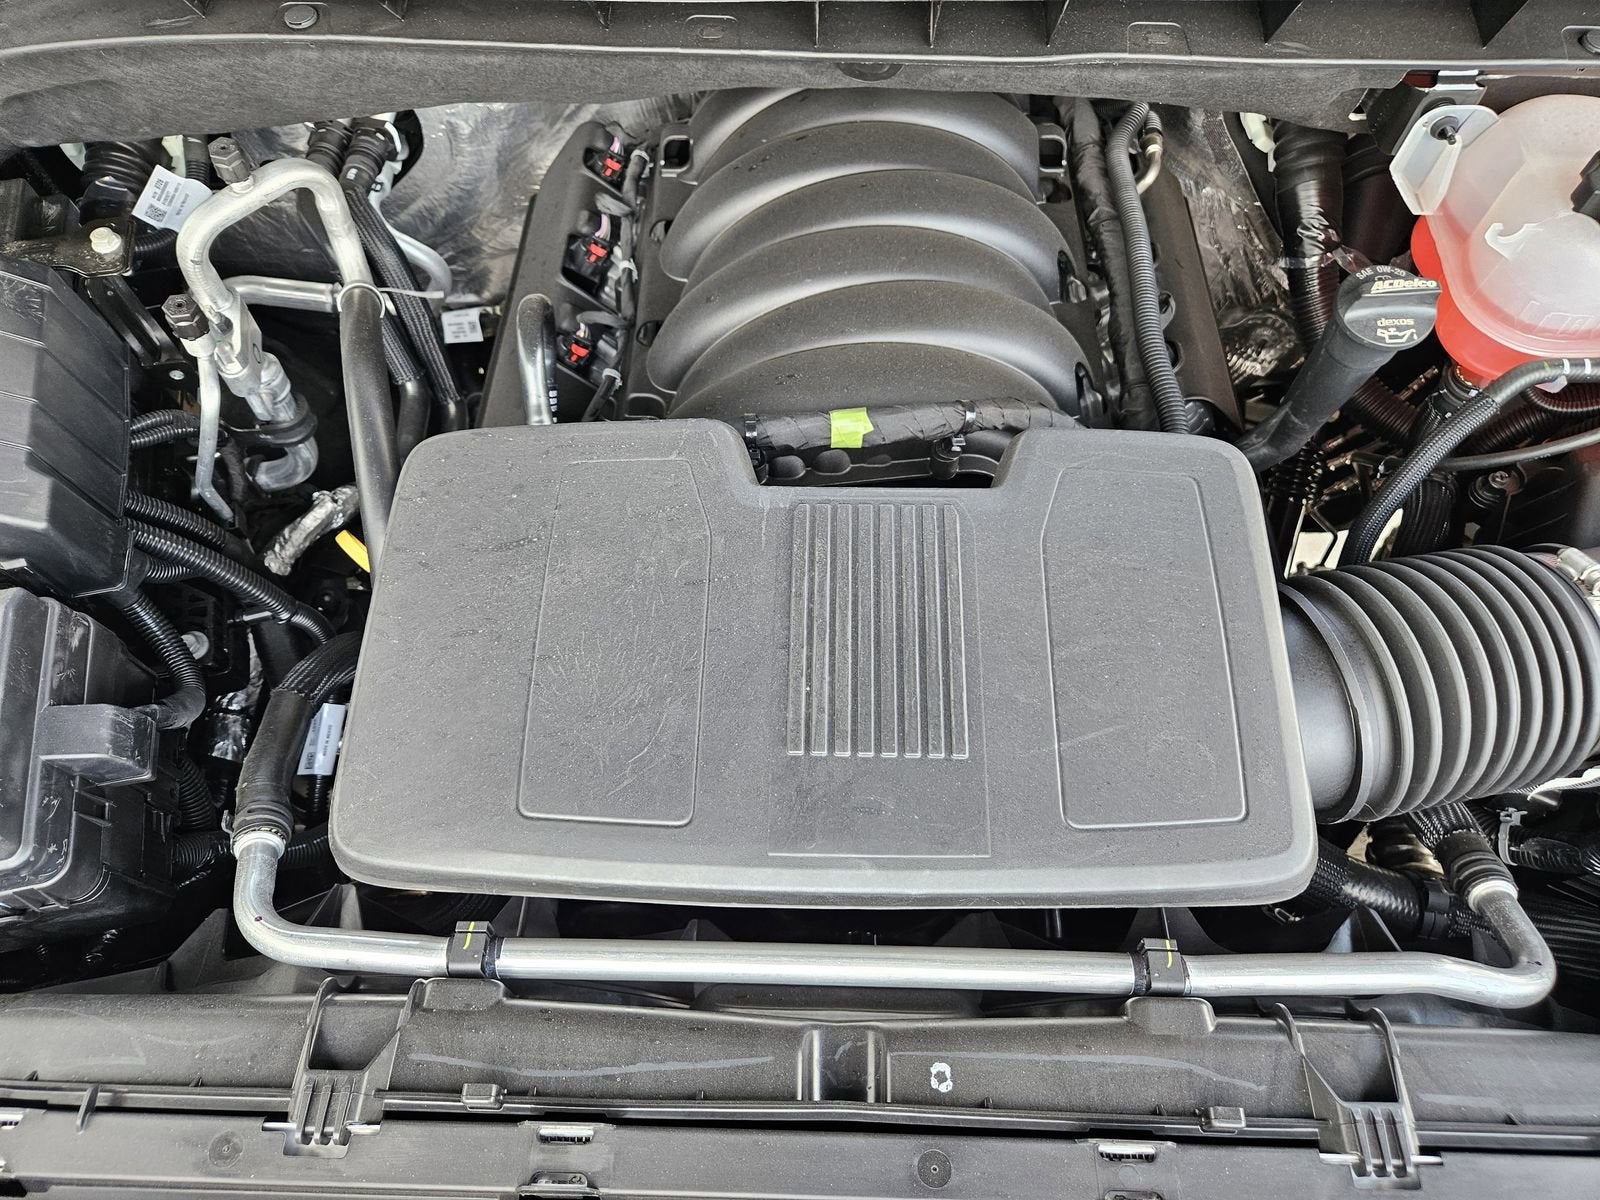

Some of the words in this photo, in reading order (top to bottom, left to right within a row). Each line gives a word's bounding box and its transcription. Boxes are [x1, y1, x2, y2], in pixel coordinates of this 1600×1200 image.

[1355, 267, 1374, 280] SAE
[1376, 265, 1406, 277] 0W-20
[1371, 279, 1437, 291] ACDelco
[1377, 318, 1415, 327] dexos
